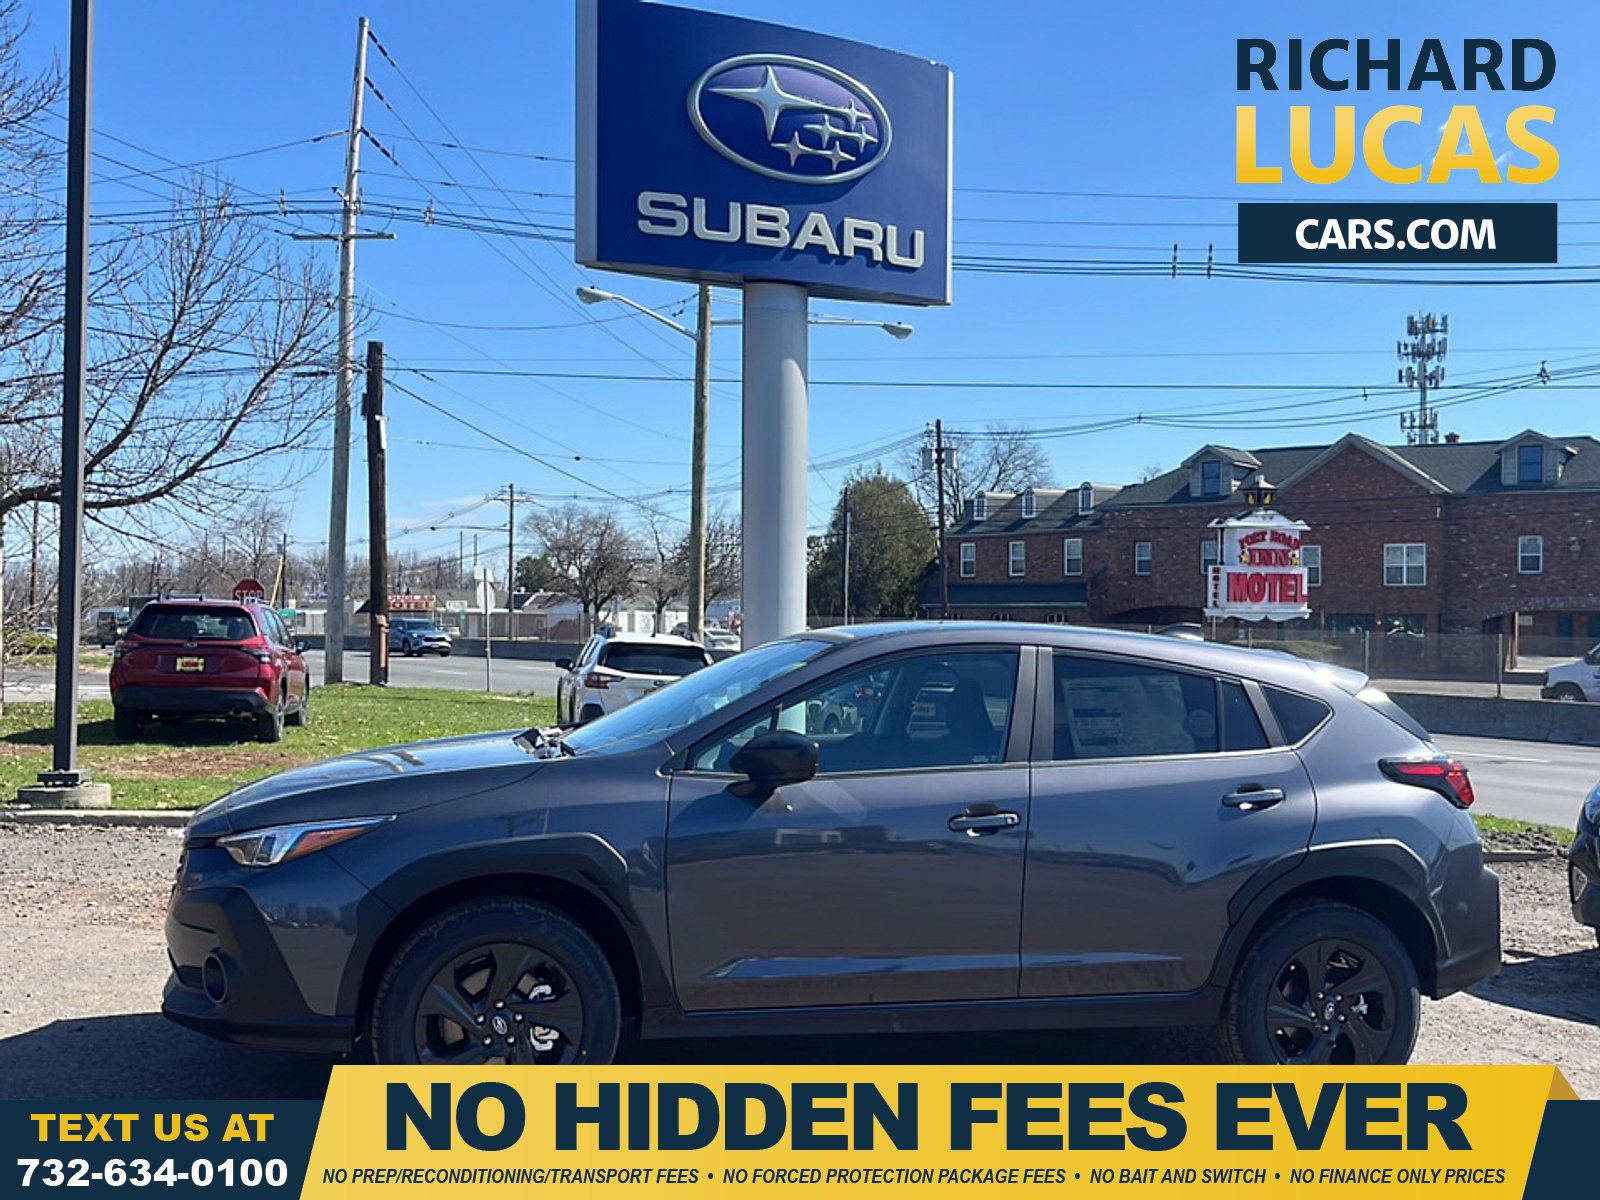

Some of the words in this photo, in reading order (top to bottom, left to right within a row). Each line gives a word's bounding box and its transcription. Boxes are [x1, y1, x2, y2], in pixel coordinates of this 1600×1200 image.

[637, 191, 925, 268] SUBARU
[1271, 530, 1299, 550] ROAD
[1248, 549, 1290, 567] INN
[234, 590, 263, 601] STOP
[1226, 572, 1309, 604] MOTEL
